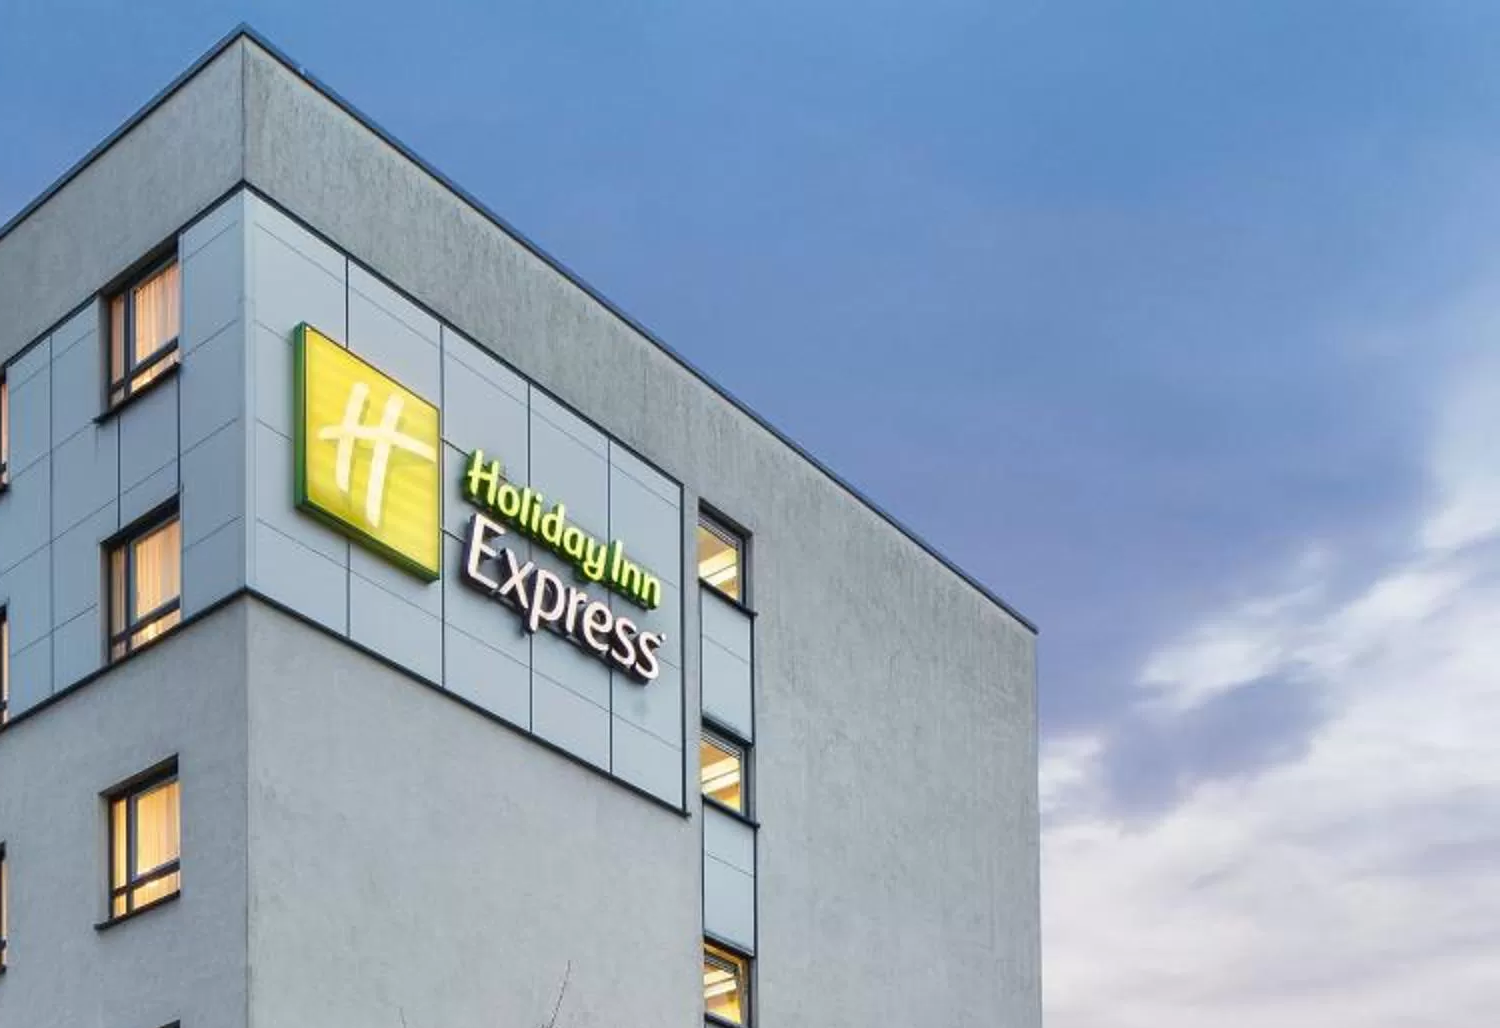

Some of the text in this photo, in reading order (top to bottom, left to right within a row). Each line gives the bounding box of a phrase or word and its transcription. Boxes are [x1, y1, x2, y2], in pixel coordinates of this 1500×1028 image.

[465, 513, 660, 681] Express
[466, 448, 661, 610] Holiday Inn
